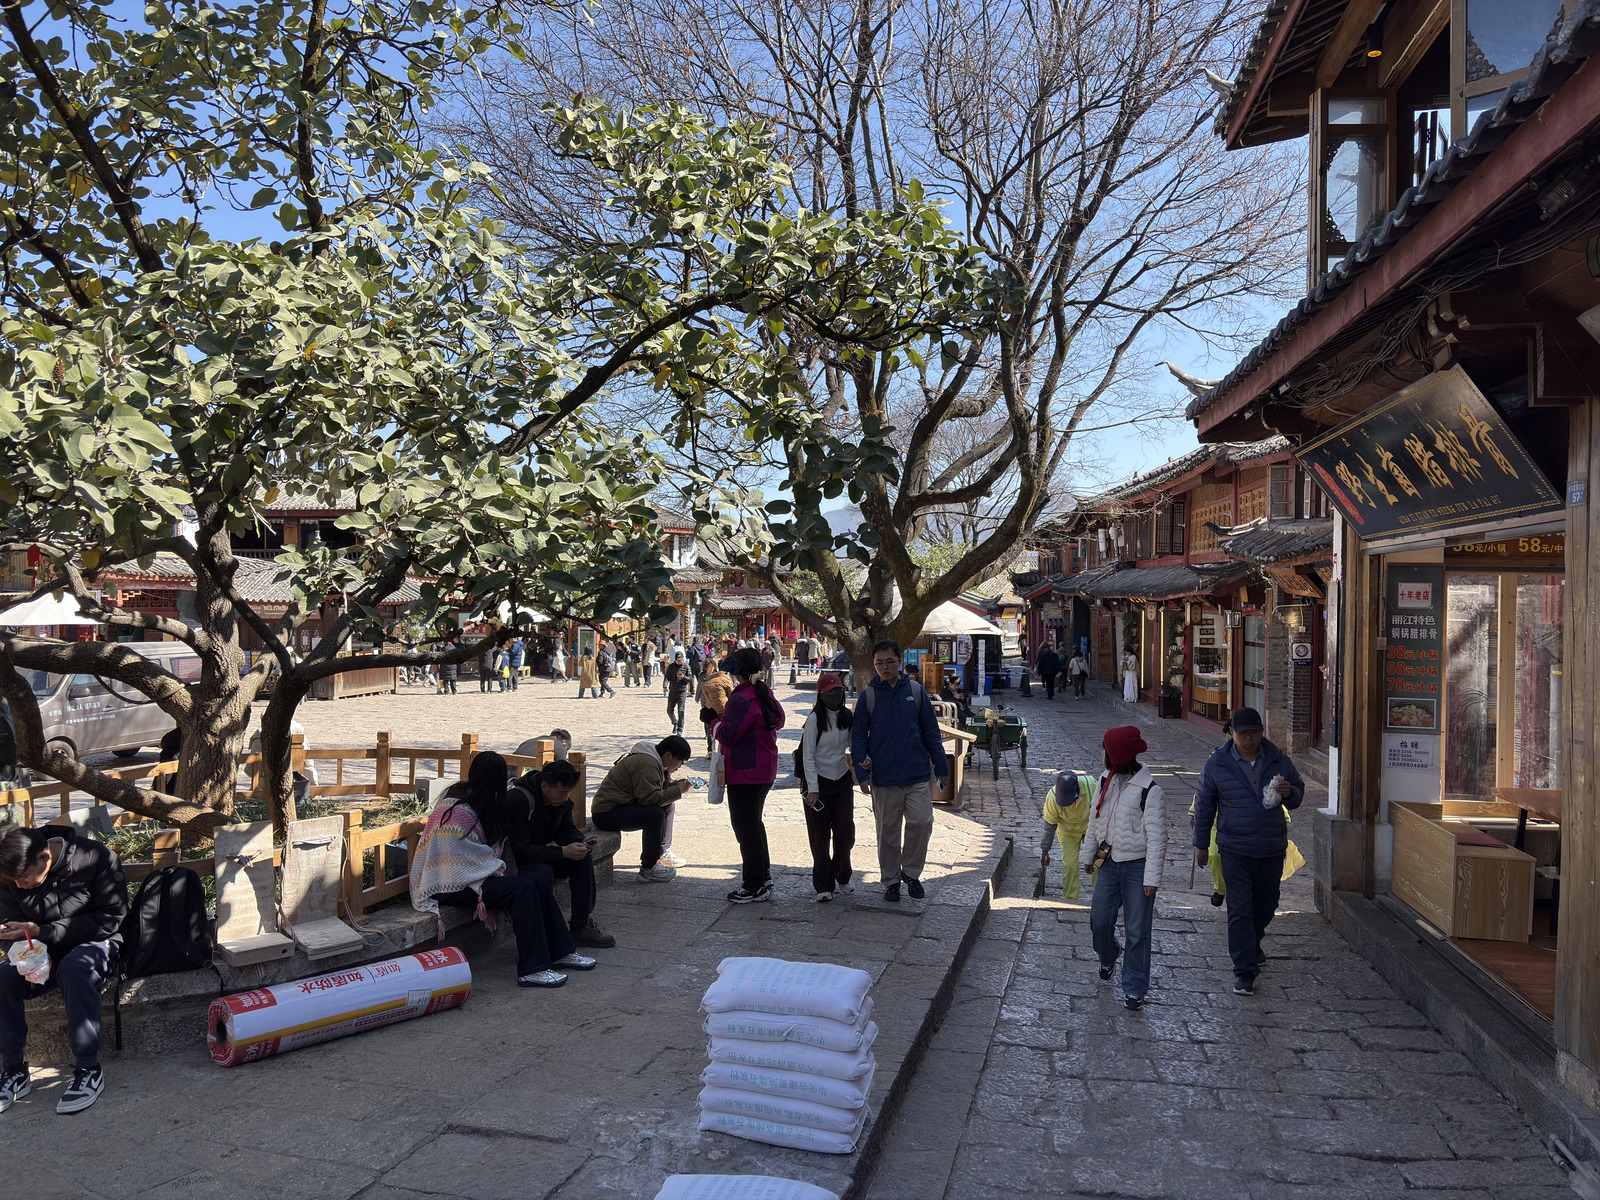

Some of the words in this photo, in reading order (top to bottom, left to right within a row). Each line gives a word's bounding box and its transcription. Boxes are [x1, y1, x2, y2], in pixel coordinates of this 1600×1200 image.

[1518, 537, 1566, 553] 58元/中
[1399, 590, 1430, 600] 十年老店
[1391, 615, 1436, 626] 丽江特色
[1391, 627, 1438, 640] 铜锅腊排骨
[1387, 645, 1439, 660] 38元/小锅
[1386, 661, 1438, 677] 58元/中锅
[1386, 678, 1437, 693] 78元/大锅
[297, 971, 364, 994] 如盾防水
